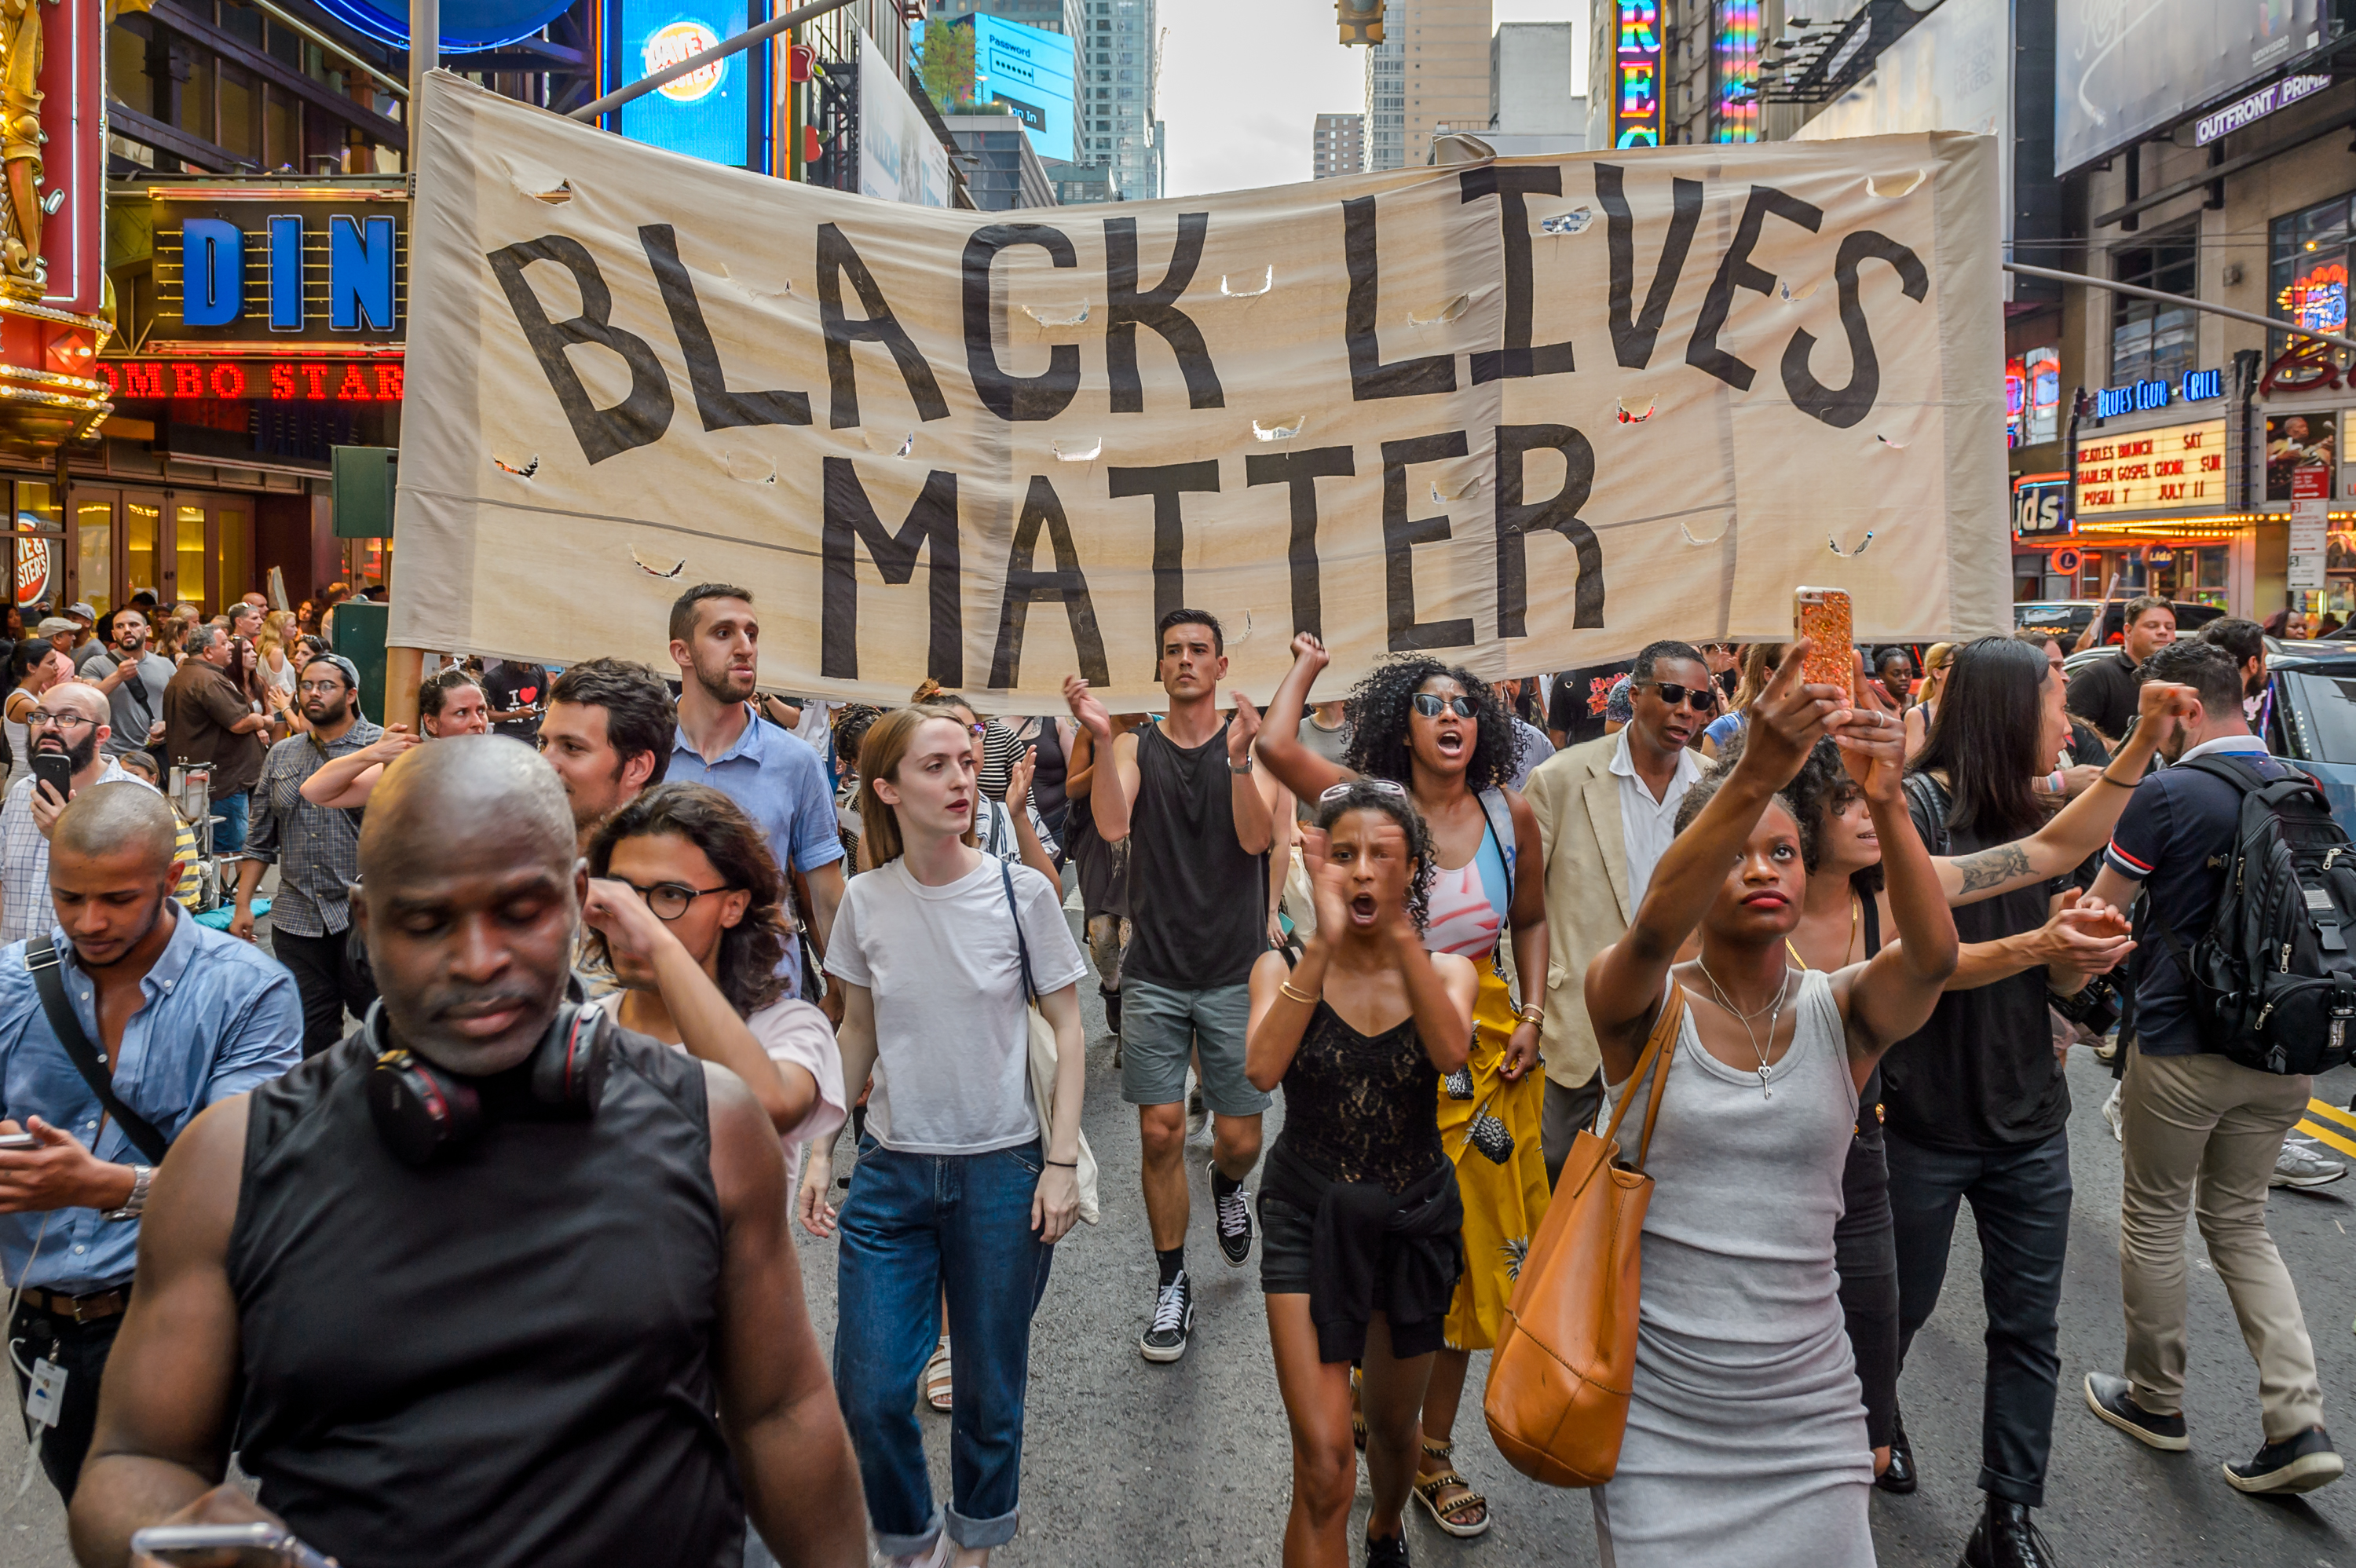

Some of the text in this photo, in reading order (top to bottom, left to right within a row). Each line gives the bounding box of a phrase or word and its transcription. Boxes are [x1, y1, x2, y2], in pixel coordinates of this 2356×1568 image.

[990, 34, 1030, 57] Password
[1026, 111, 1037, 123] In
[2199, 87, 2276, 141] OUTFRONT
[183, 215, 394, 332] DIN
[487, 162, 1929, 465] BLACK LIVES
[2097, 385, 2133, 418] BLUES
[2136, 378, 2168, 411] CLUB
[2182, 370, 2221, 402] GRILL
[2078, 431, 2203, 463] BEATLES BRUNCH SAT
[2077, 454, 2221, 485] HARLEM GOSPEL CHOIR SUN
[2012, 487, 2060, 532] ids
[2083, 481, 2204, 506] PUSHA T JULY 11
[18, 553, 46, 589] STER'S
[821, 424, 1605, 689] MATTER
[2149, 550, 2172, 562] Lids
[508, 689, 520, 706] I
